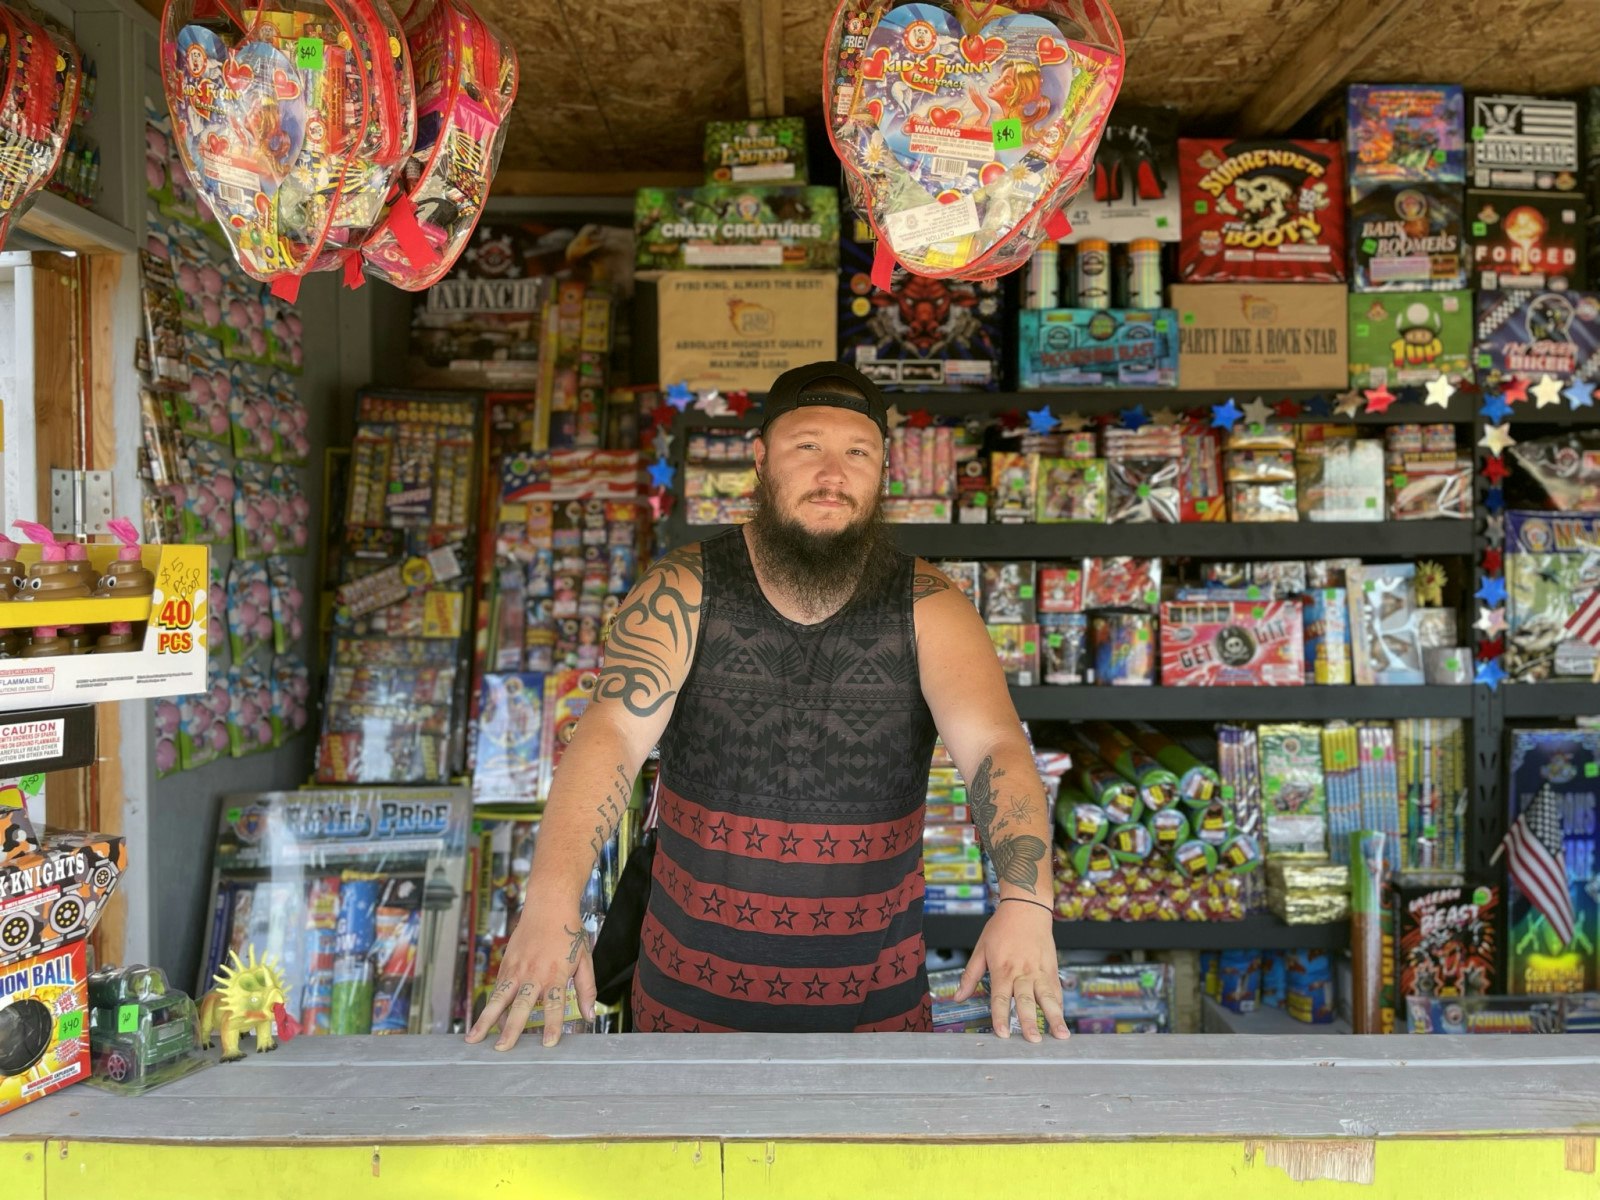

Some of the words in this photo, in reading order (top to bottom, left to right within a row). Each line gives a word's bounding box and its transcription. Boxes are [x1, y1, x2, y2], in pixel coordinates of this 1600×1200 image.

[300, 46, 317, 60] $40
[882, 57, 929, 74] KID'S
[934, 59, 994, 74] FUNNY
[914, 124, 961, 138] WARNING
[996, 125, 1015, 143] $40
[1198, 149, 1326, 197] SURRENDER
[661, 223, 718, 238] CRAZY
[722, 223, 822, 238] CREATURES
[1224, 216, 1322, 248] BOOTY
[1362, 221, 1407, 237] BABY
[1377, 235, 1458, 255] BOOMERS
[1475, 245, 1577, 265] FORGED
[774, 279, 793, 290] THE
[779, 339, 823, 349] QUALITY
[1179, 328, 1219, 355] PARTY
[1222, 328, 1251, 355] LIKE
[1255, 328, 1264, 355] A
[1267, 328, 1302, 355] ROCK
[1304, 328, 1338, 355] STAR
[709, 360, 760, 369] MAXIMUM
[762, 360, 790, 369] LOAD
[158, 599, 194, 630] 40
[158, 632, 193, 654] PCS
[1180, 643, 1214, 668] GET
[2, 722, 56, 737] CAUTION
[379, 802, 449, 833] PRIDE
[1420, 903, 1480, 937] BEAST
[33, 955, 75, 987] BALL
[62, 1002, 74, 1013] PCS
[62, 1017, 80, 1033] $40
